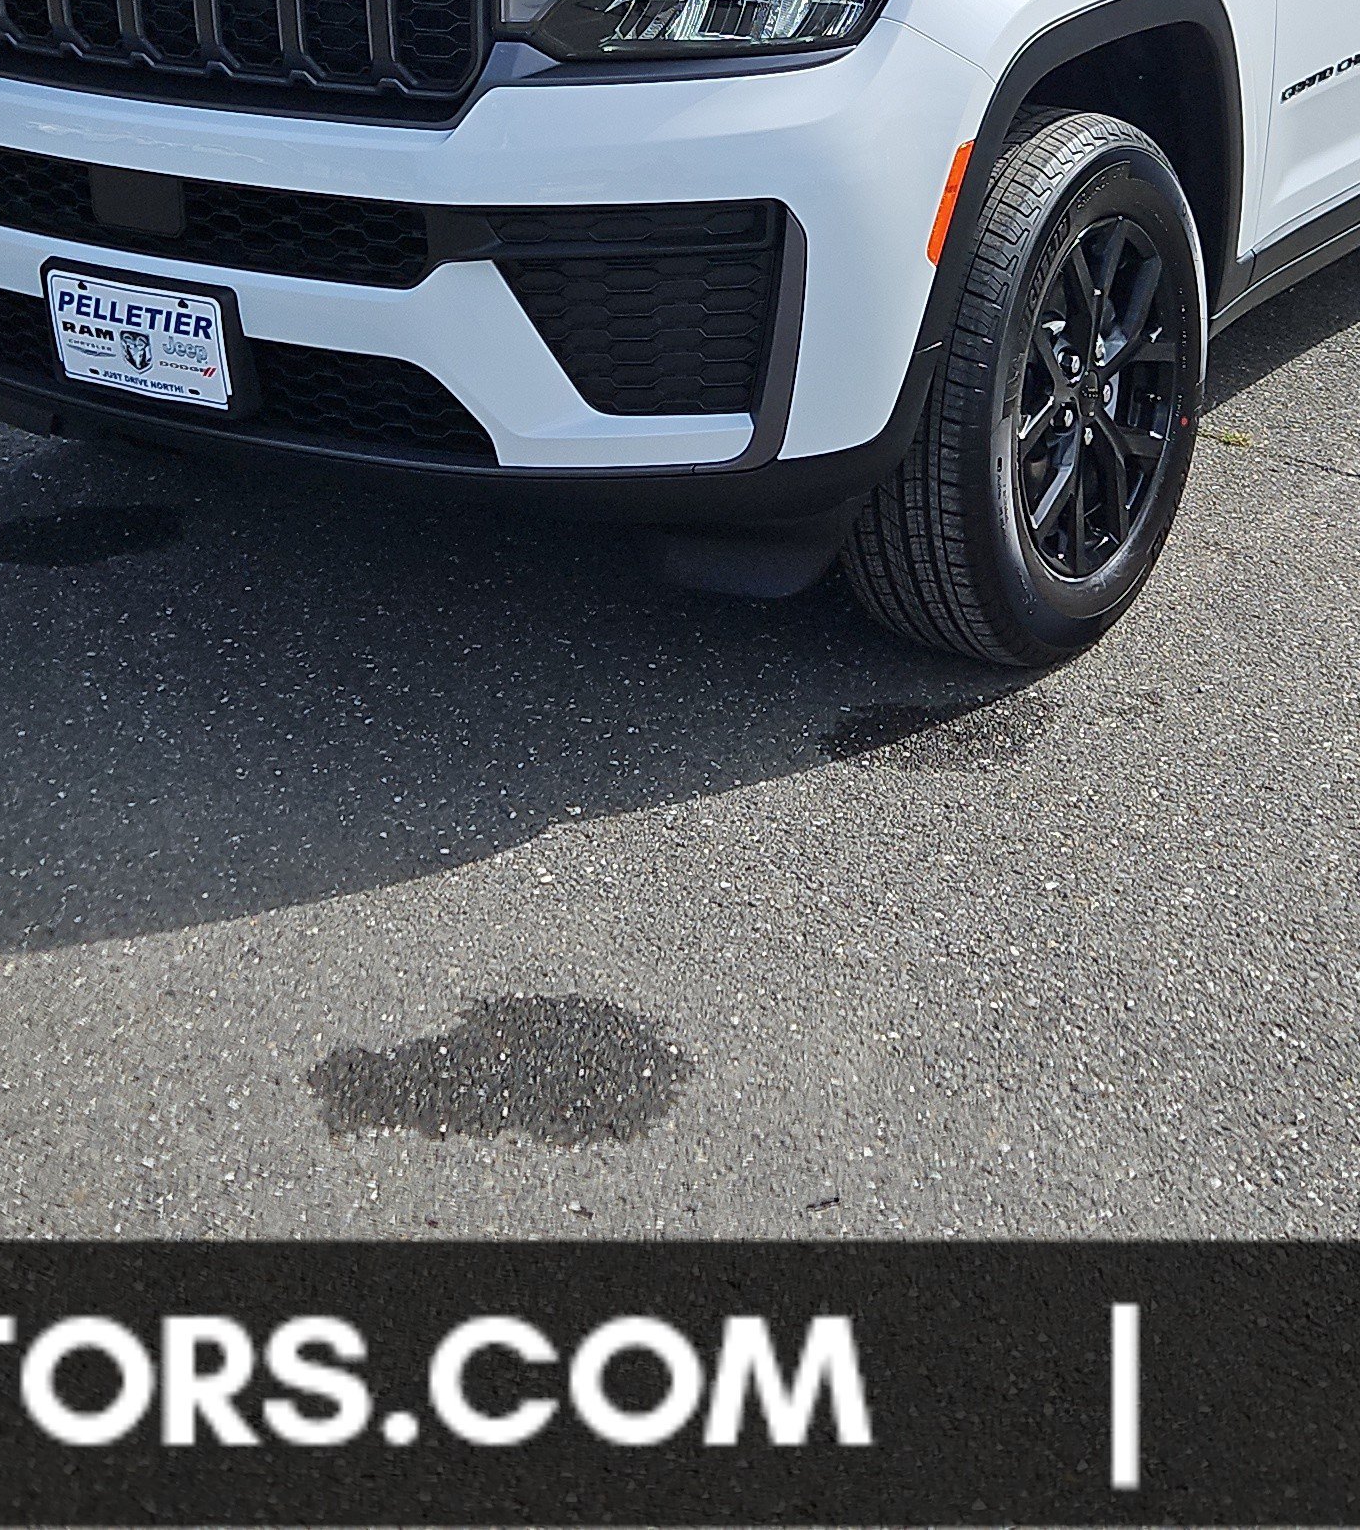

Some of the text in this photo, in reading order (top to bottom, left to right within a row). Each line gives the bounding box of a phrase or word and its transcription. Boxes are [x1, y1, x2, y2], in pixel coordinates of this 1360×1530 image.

[58, 290, 213, 340] PELLETIER
[61, 320, 115, 342] RAM
[162, 335, 208, 364] Jeep
[103, 370, 123, 382] JUST
[124, 374, 149, 388] DRIVE
